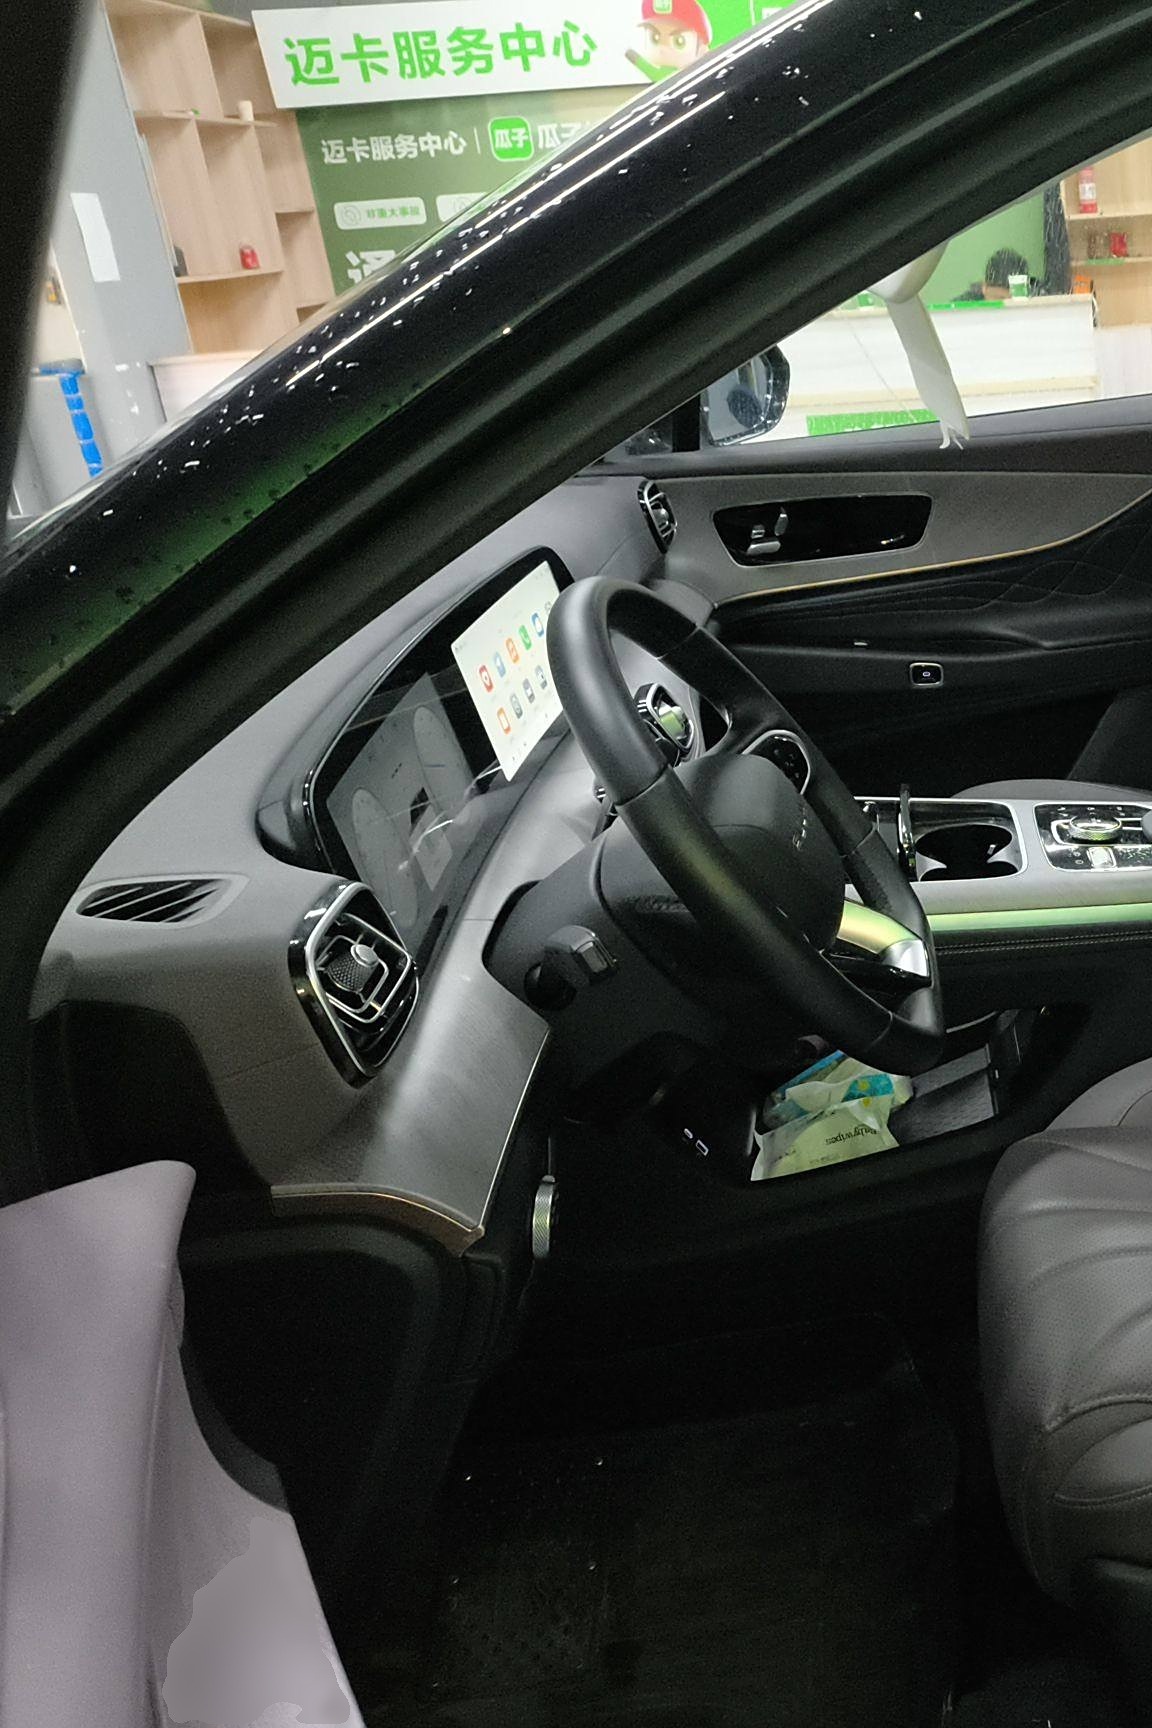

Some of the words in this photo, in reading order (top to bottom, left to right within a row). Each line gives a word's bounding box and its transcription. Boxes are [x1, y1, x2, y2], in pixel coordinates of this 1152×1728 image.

[284, 20, 597, 85] 迈卡服务中心
[321, 131, 467, 164] 迈卡服务中心
[494, 127, 529, 149] 瓜子
[537, 122, 590, 150] 瓜子
